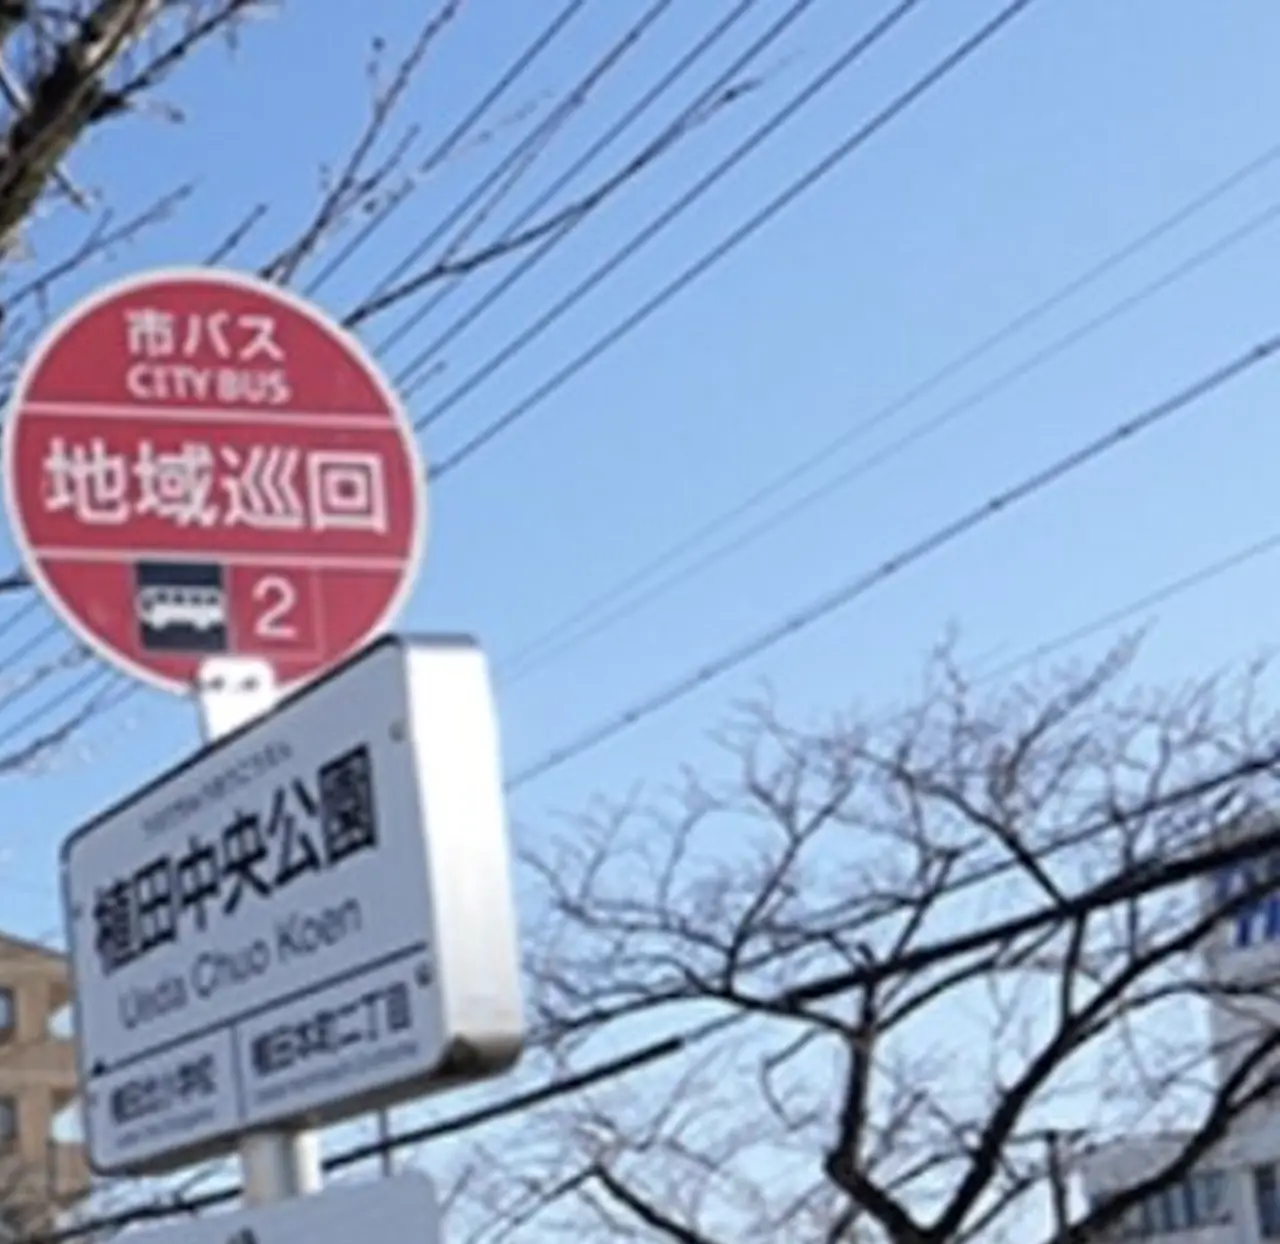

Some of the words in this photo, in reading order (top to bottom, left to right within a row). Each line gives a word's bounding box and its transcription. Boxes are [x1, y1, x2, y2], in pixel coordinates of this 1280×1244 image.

[124, 307, 286, 362] 市バス
[126, 365, 211, 399] CITY
[218, 368, 290, 404] BUS
[43, 436, 389, 534] 地域巡回
[252, 575, 299, 640] 2
